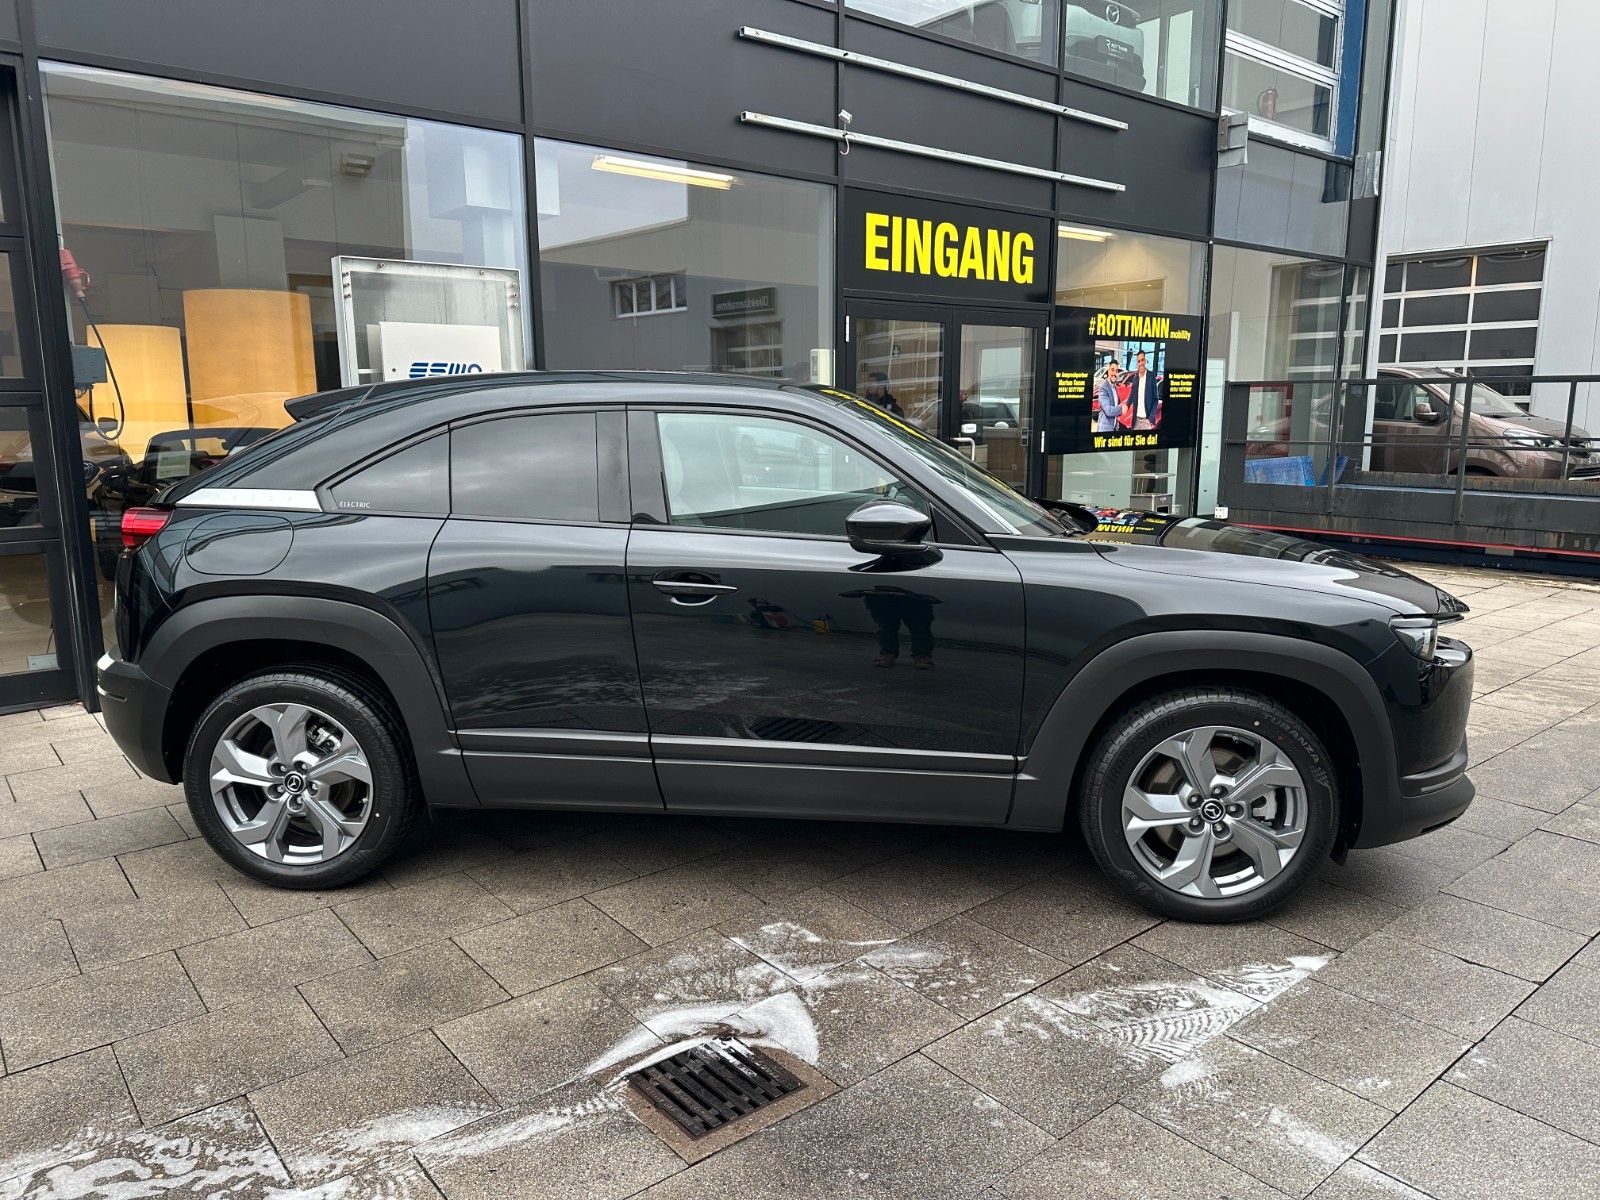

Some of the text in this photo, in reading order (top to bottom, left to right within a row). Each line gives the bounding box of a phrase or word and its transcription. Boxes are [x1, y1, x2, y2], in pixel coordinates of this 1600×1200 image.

[865, 212, 1034, 284] EINGANG
[1088, 313, 1191, 341] #ROTTMANN mobility
[1094, 434, 1158, 448] Wir sind für Sie da!
[339, 501, 371, 509] ELECTRIC
[1263, 713, 1320, 764] TURANZA
